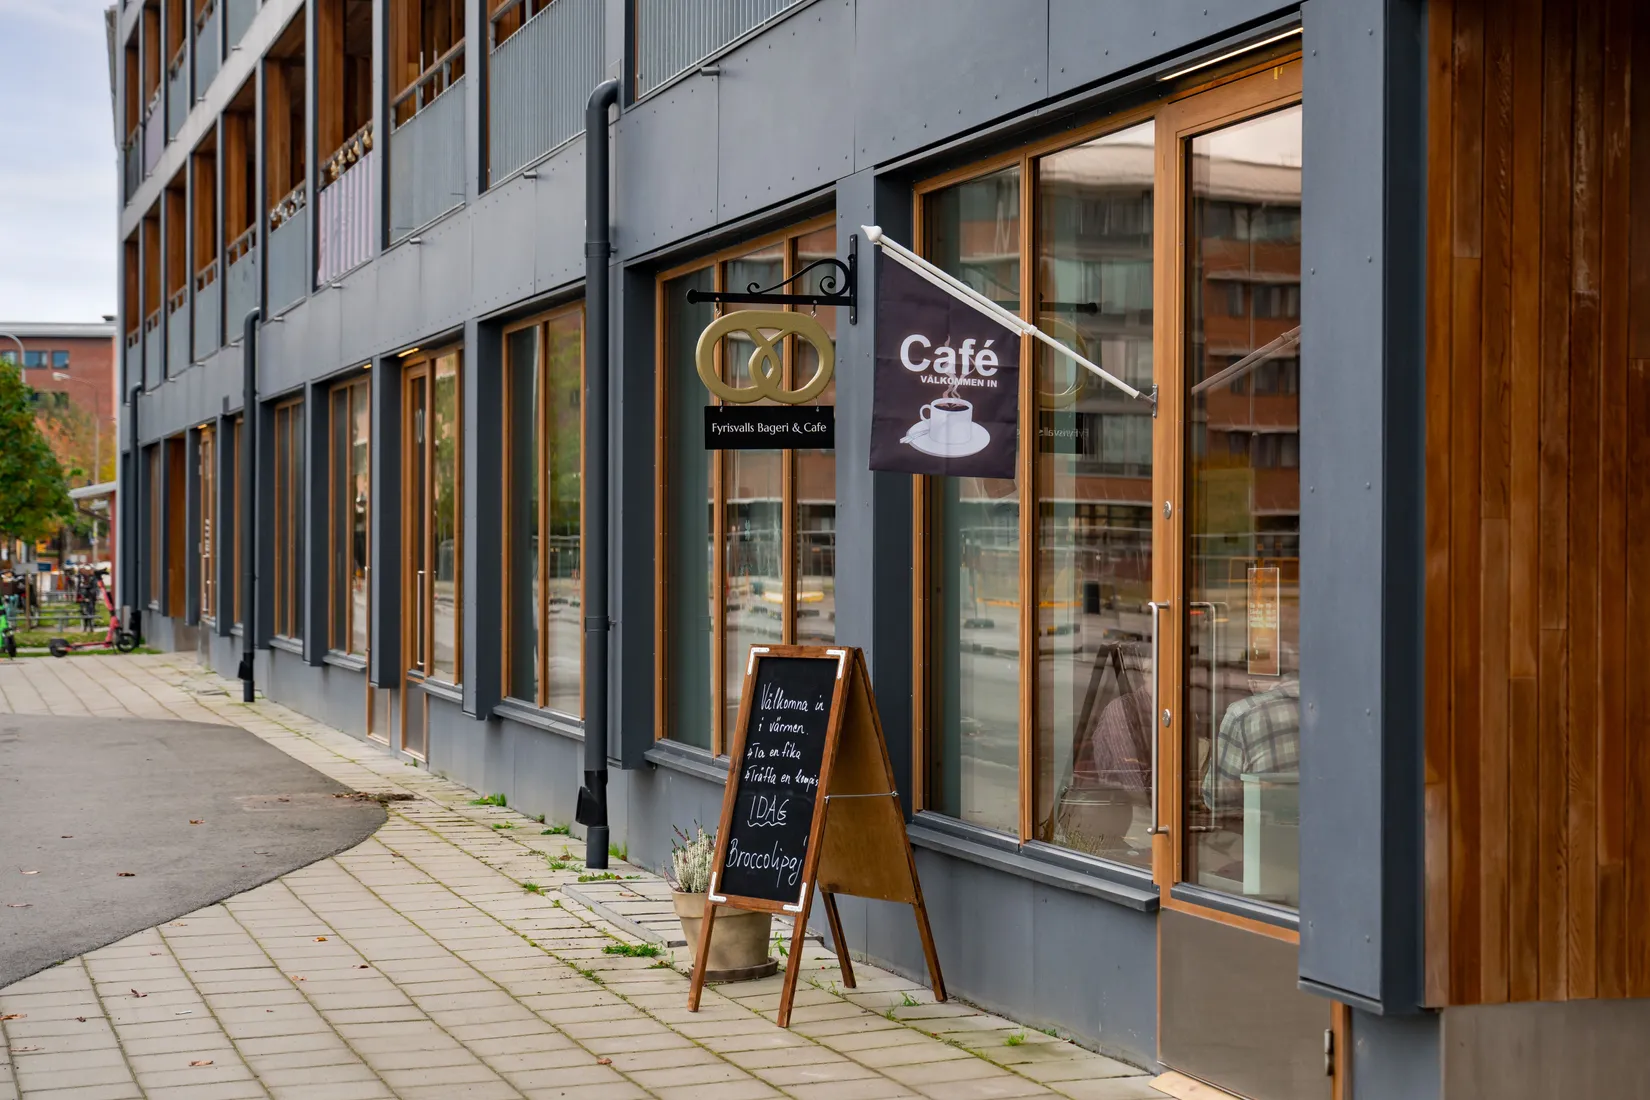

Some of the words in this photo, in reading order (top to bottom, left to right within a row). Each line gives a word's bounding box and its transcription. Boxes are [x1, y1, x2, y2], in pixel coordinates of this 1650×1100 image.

[900, 334, 999, 377] Café
[920, 375, 984, 387] VÄLKOMMEN
[987, 380, 998, 388] IN
[712, 422, 755, 435] Fyrisvalls
[757, 422, 789, 435] Bageri
[791, 422, 803, 434] &
[803, 422, 827, 433] Cafe
[761, 682, 809, 712] Välkomna
[814, 694, 824, 711] in
[758, 716, 764, 732] i
[769, 748, 780, 757] en
[781, 741, 801, 760] fika
[781, 774, 791, 785] en
[750, 794, 789, 823] IDAG
